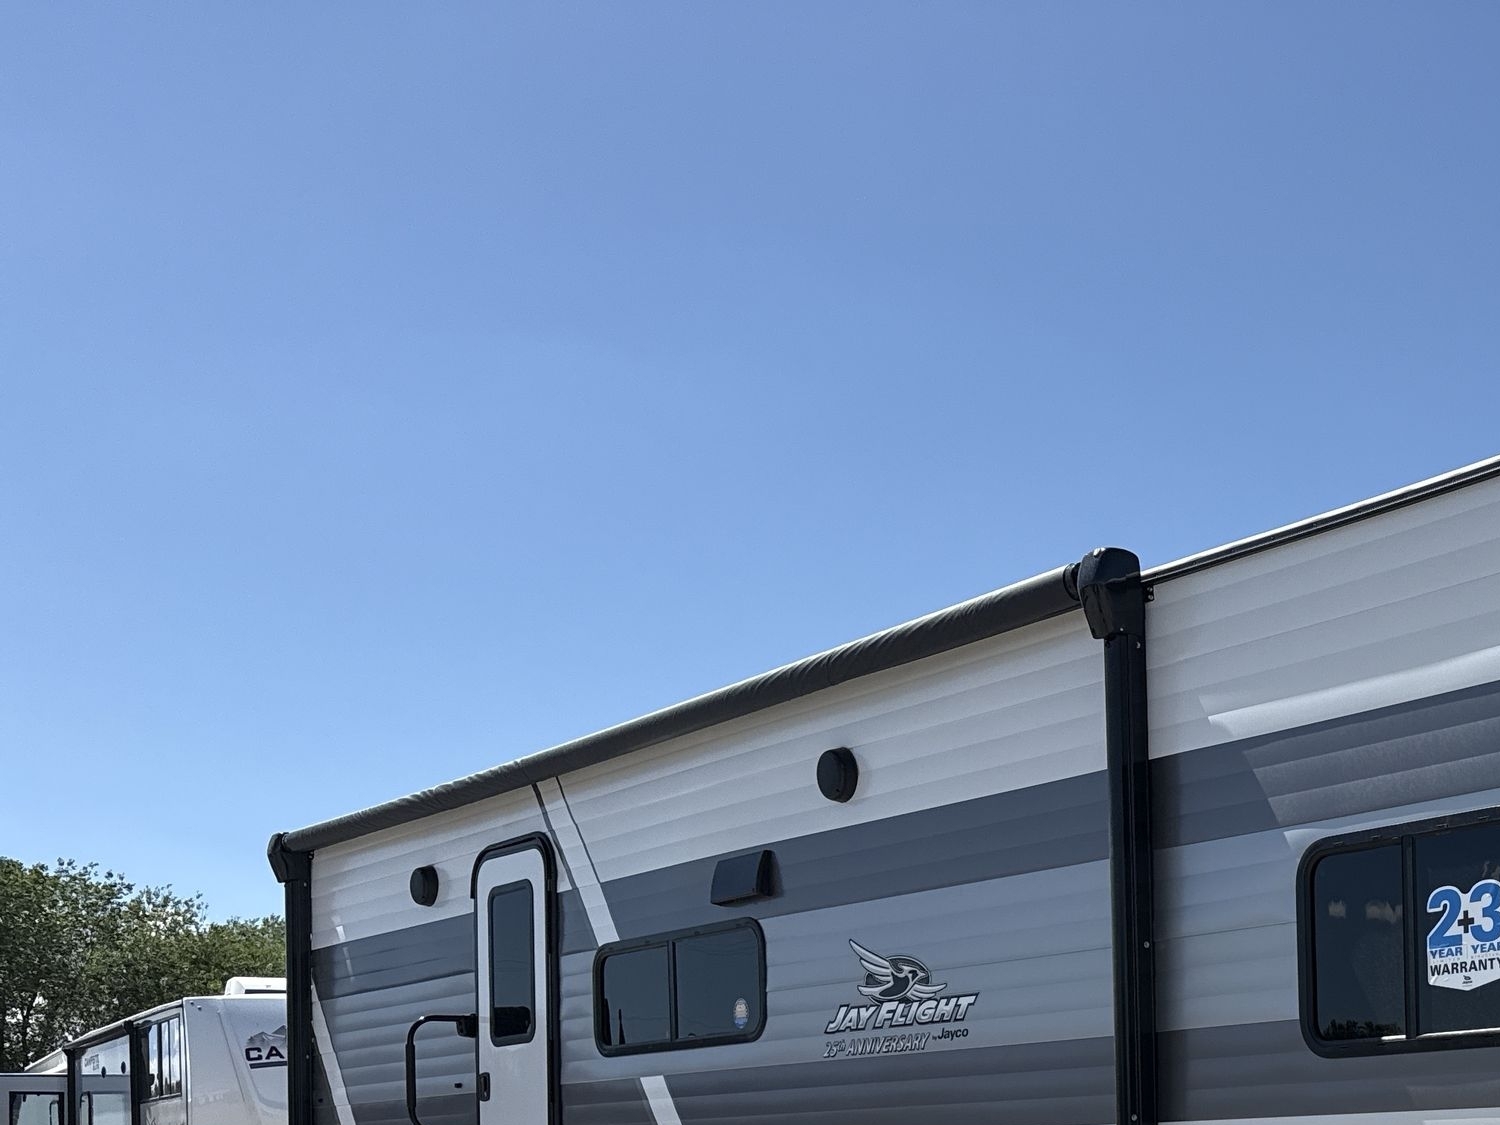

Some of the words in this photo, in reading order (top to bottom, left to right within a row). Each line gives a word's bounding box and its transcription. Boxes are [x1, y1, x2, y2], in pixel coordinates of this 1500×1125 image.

[1429, 947, 1463, 959] YEAR
[824, 1004, 877, 1034] JAY
[874, 992, 979, 1030] FLIGHT
[937, 1026, 969, 1041] Jayco
[823, 1039, 846, 1058] 25th
[846, 1032, 931, 1056] ANNIVERSARY
